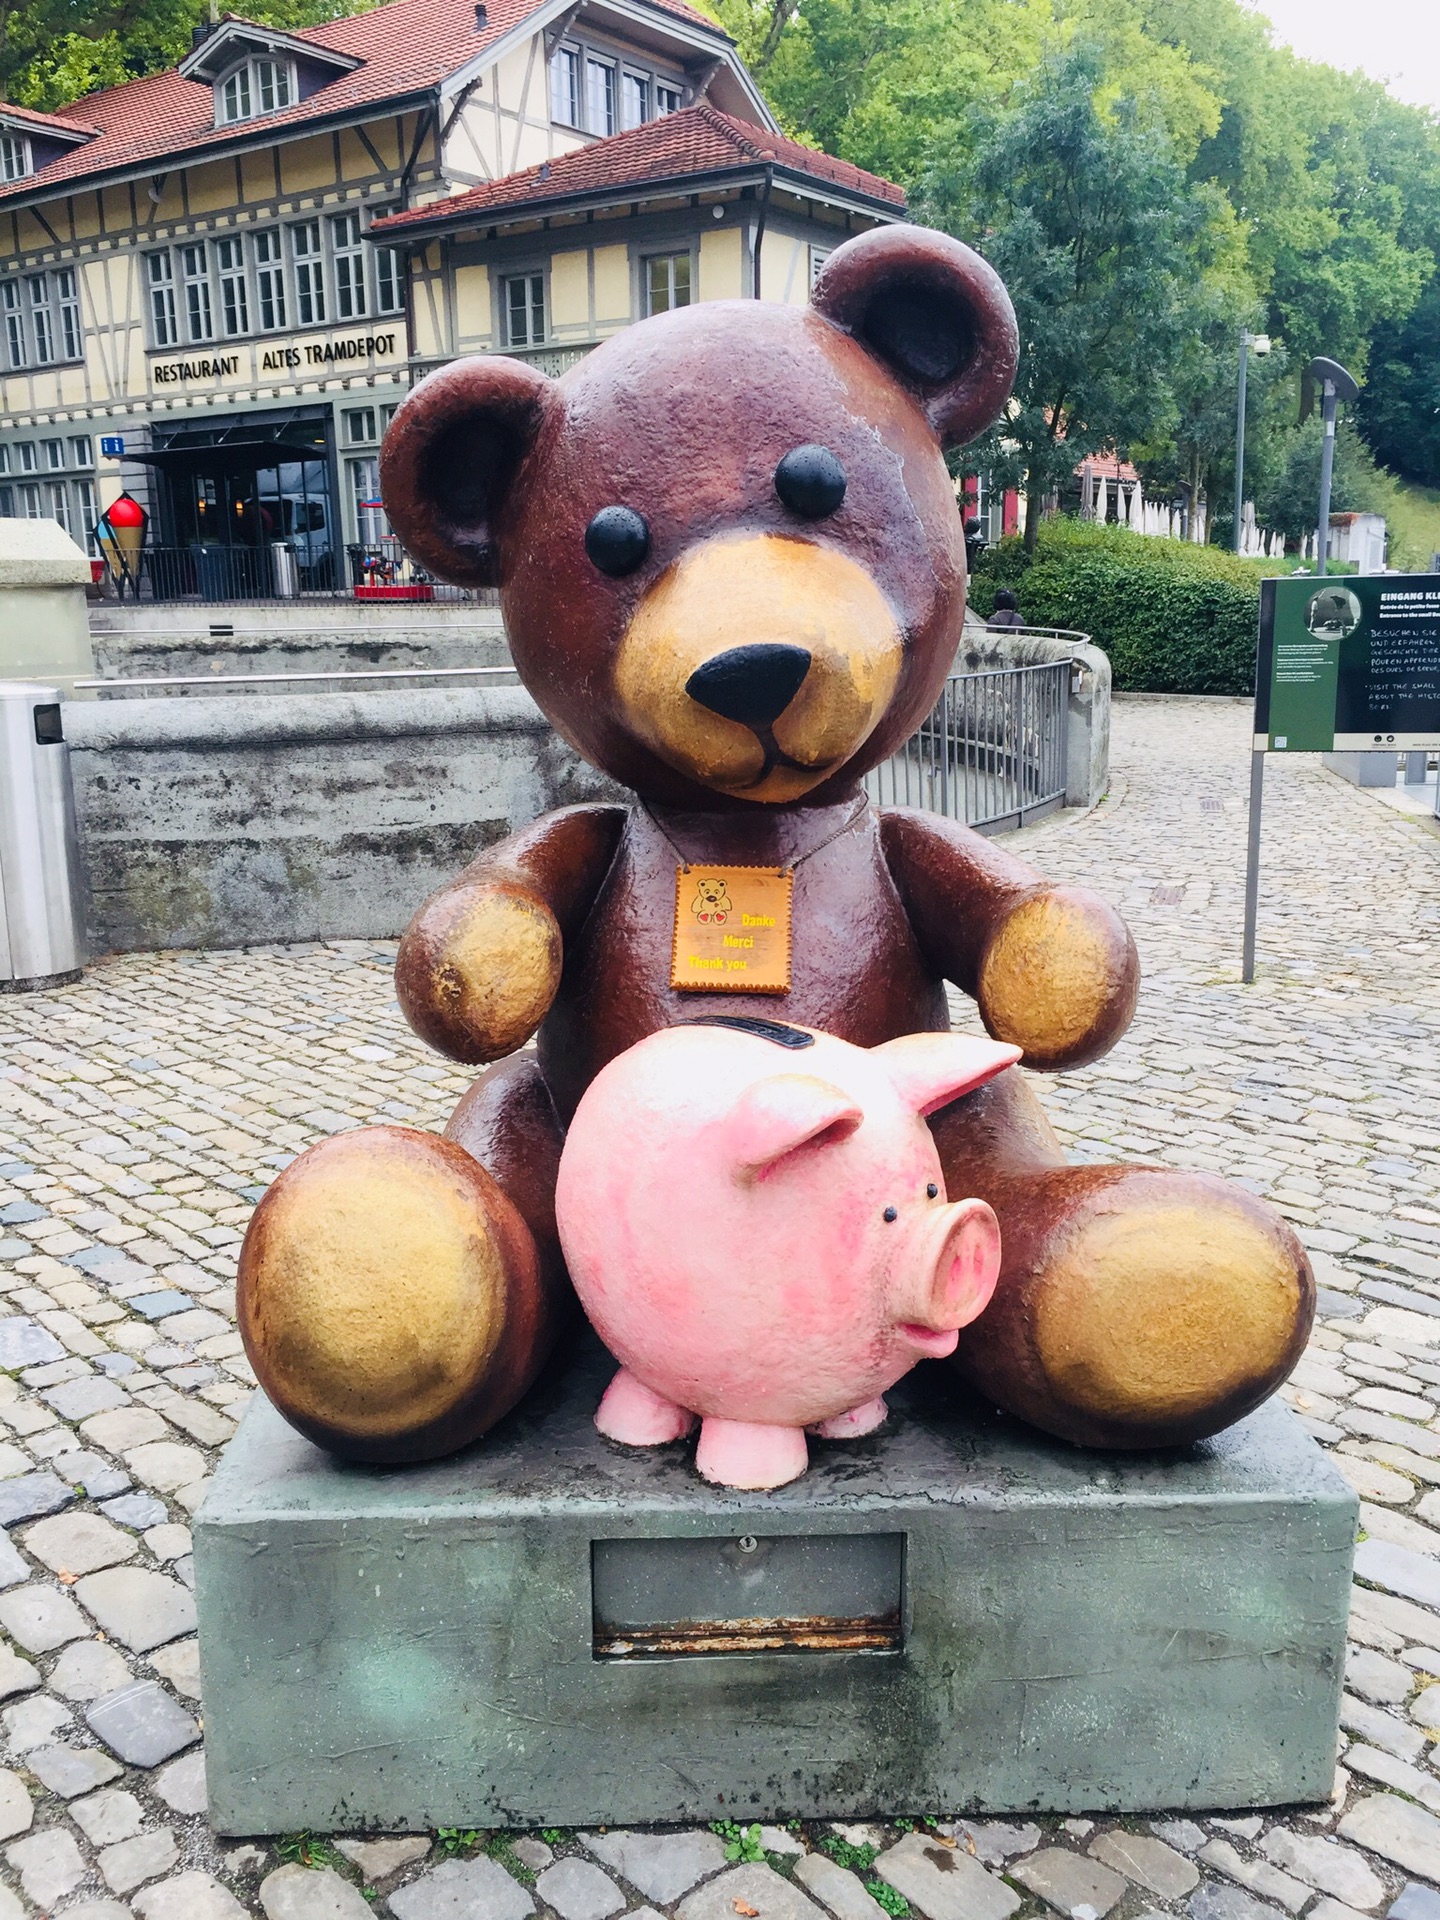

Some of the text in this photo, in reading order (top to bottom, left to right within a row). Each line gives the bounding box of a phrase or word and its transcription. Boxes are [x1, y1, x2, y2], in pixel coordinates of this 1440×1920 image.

[154, 334, 396, 383] RESTAURANT ALTES TRAMDEPOT
[1381, 592, 1423, 601] EINGANG
[1422, 629, 1438, 637] SIE
[742, 913, 776, 927] Danke
[723, 935, 754, 948] Merci
[688, 955, 747, 972] Thank you
